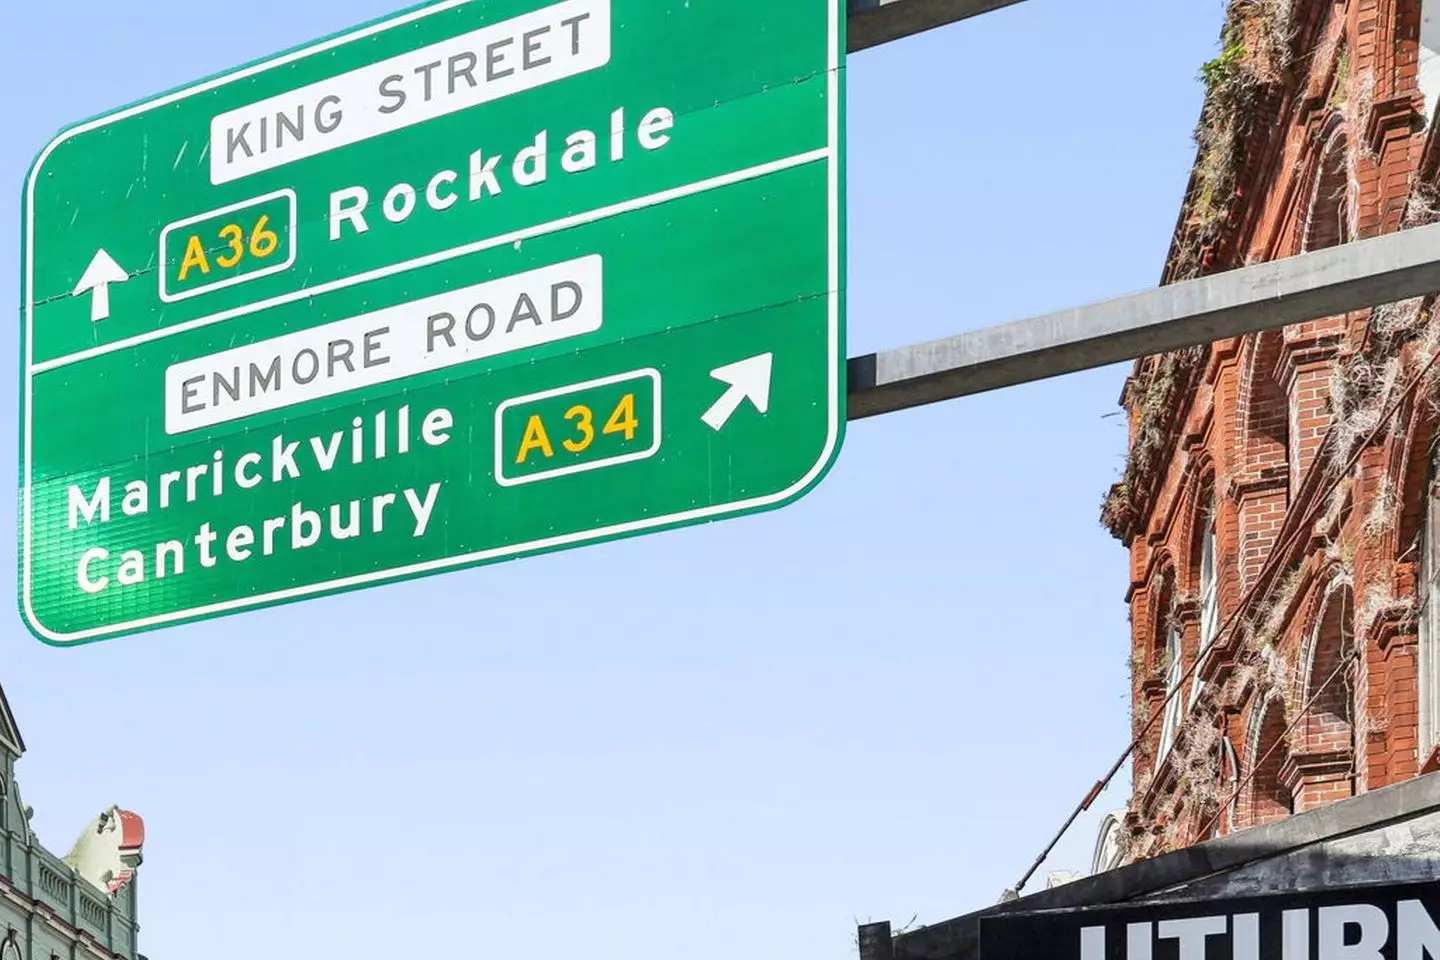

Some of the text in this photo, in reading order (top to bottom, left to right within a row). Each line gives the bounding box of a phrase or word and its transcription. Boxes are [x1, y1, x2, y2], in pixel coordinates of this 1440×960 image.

[226, 12, 591, 164] KING STREET
[177, 106, 675, 281] A36 Rockdale
[181, 280, 584, 415] ENMORE ROAD
[67, 403, 454, 530] Marrickville
[515, 393, 640, 464] A34
[76, 482, 441, 593] Canterbury
